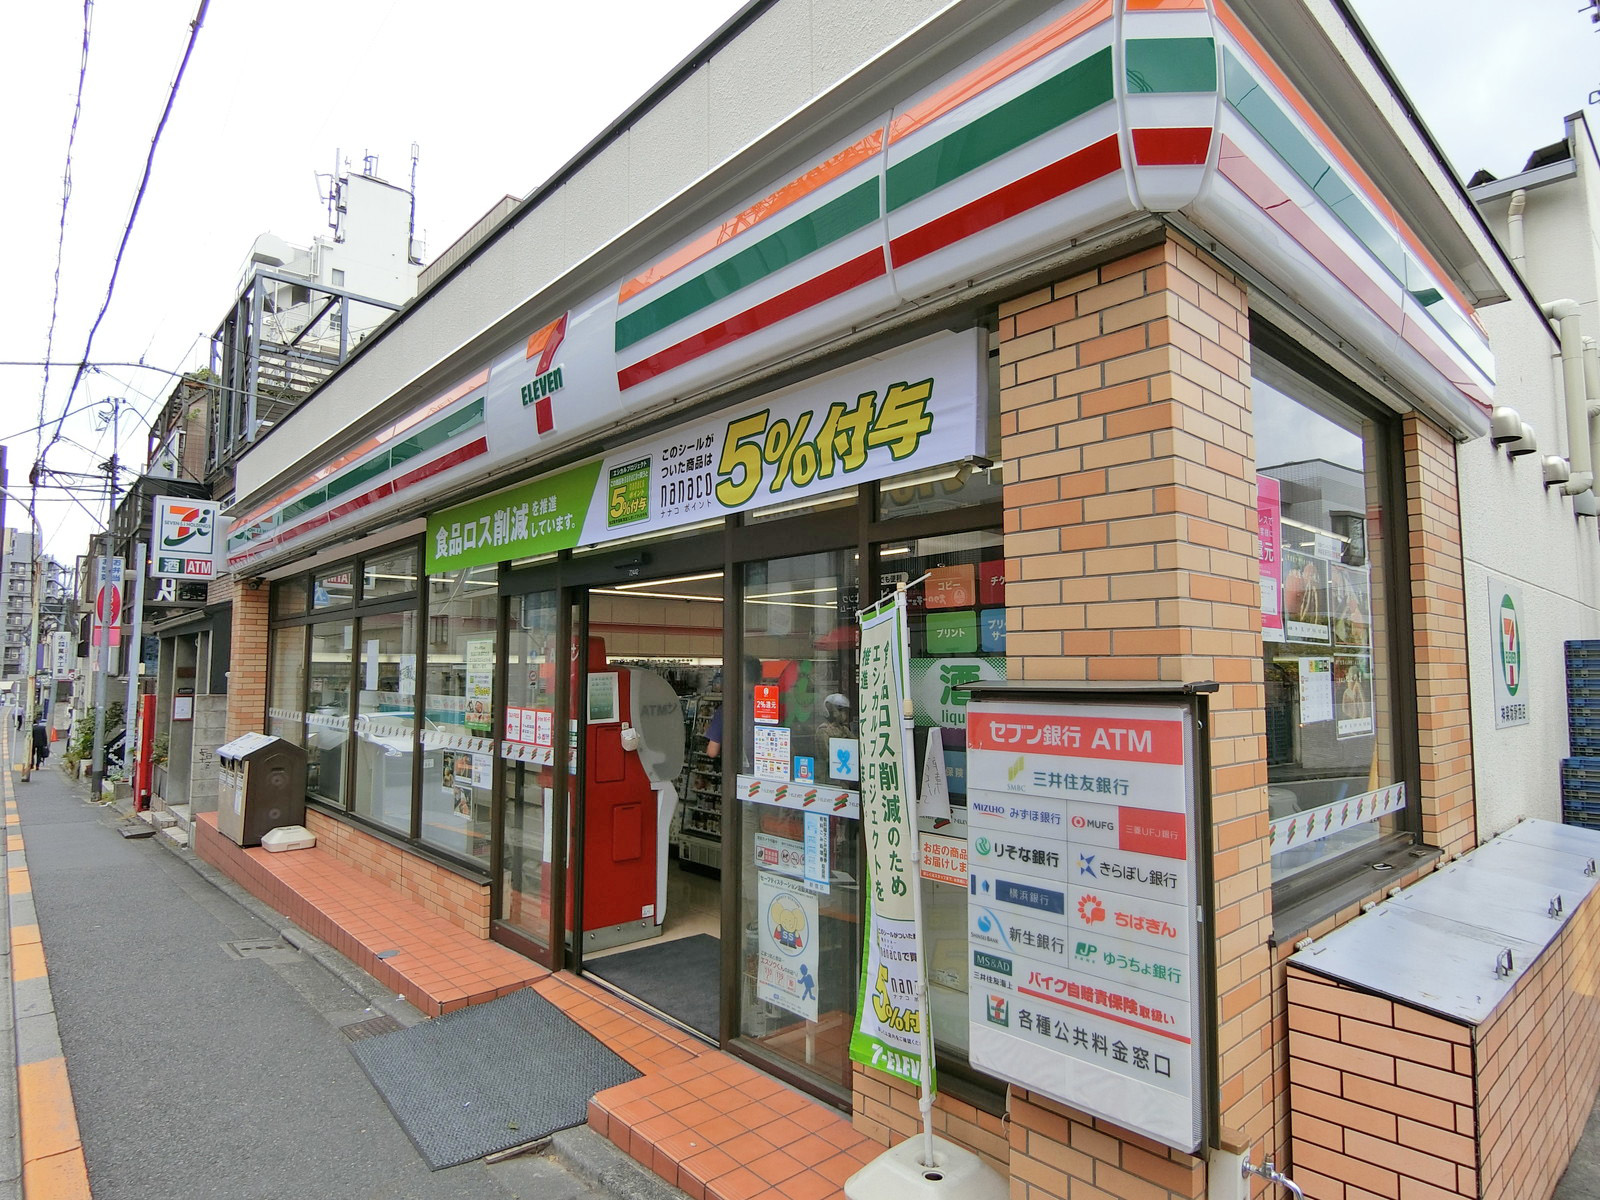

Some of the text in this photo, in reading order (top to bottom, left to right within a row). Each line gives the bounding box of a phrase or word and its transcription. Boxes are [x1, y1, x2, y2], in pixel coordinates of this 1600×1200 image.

[661, 433, 714, 461] このシールが
[715, 378, 934, 507] 5%付与
[660, 453, 713, 479] ついた商品は
[660, 472, 713, 508] nanaco
[532, 495, 558, 517] を推進
[684, 499, 713, 513] ポイント
[435, 503, 529, 560] 食品ロス削減
[531, 513, 576, 538] しています。
[164, 558, 180, 572] 酒
[187, 560, 211, 575] ATM
[937, 582, 961, 591] コピー
[936, 628, 966, 639] プリント
[988, 619, 1006, 630] プリ
[940, 664, 981, 706] 酒
[989, 721, 1152, 753] セブン銀行 ATM
[869, 645, 885, 902] エシカルプロジェクトを
[1033, 771, 1129, 796] 三井住友銀行
[1007, 784, 1026, 792] SMBC
[972, 803, 1005, 814] MIZUHO
[1009, 808, 1061, 825] みずほ銀行
[1086, 821, 1114, 831] MUFG
[1125, 825, 1178, 840] 三菱UFJ銀行
[923, 842, 968, 860] お店の商品
[993, 842, 1060, 868] りそな銀行
[923, 854, 967, 873] お届けしま
[1099, 862, 1178, 889] きらぼし銀行
[1009, 887, 1049, 906] 横浜銀行
[970, 931, 999, 944] SHINSEI BANK
[1009, 926, 1065, 954] 新生銀行
[976, 955, 1010, 972] MS&AD
[1103, 951, 1182, 984] ゆうちょ銀行
[973, 971, 1013, 991] 三井住友海上
[1028, 971, 1175, 1025] バイク自賠責保険取扱い
[1018, 1009, 1171, 1078] 各種公共料金窓口
[871, 1043, 922, 1081] 7-ELEV
